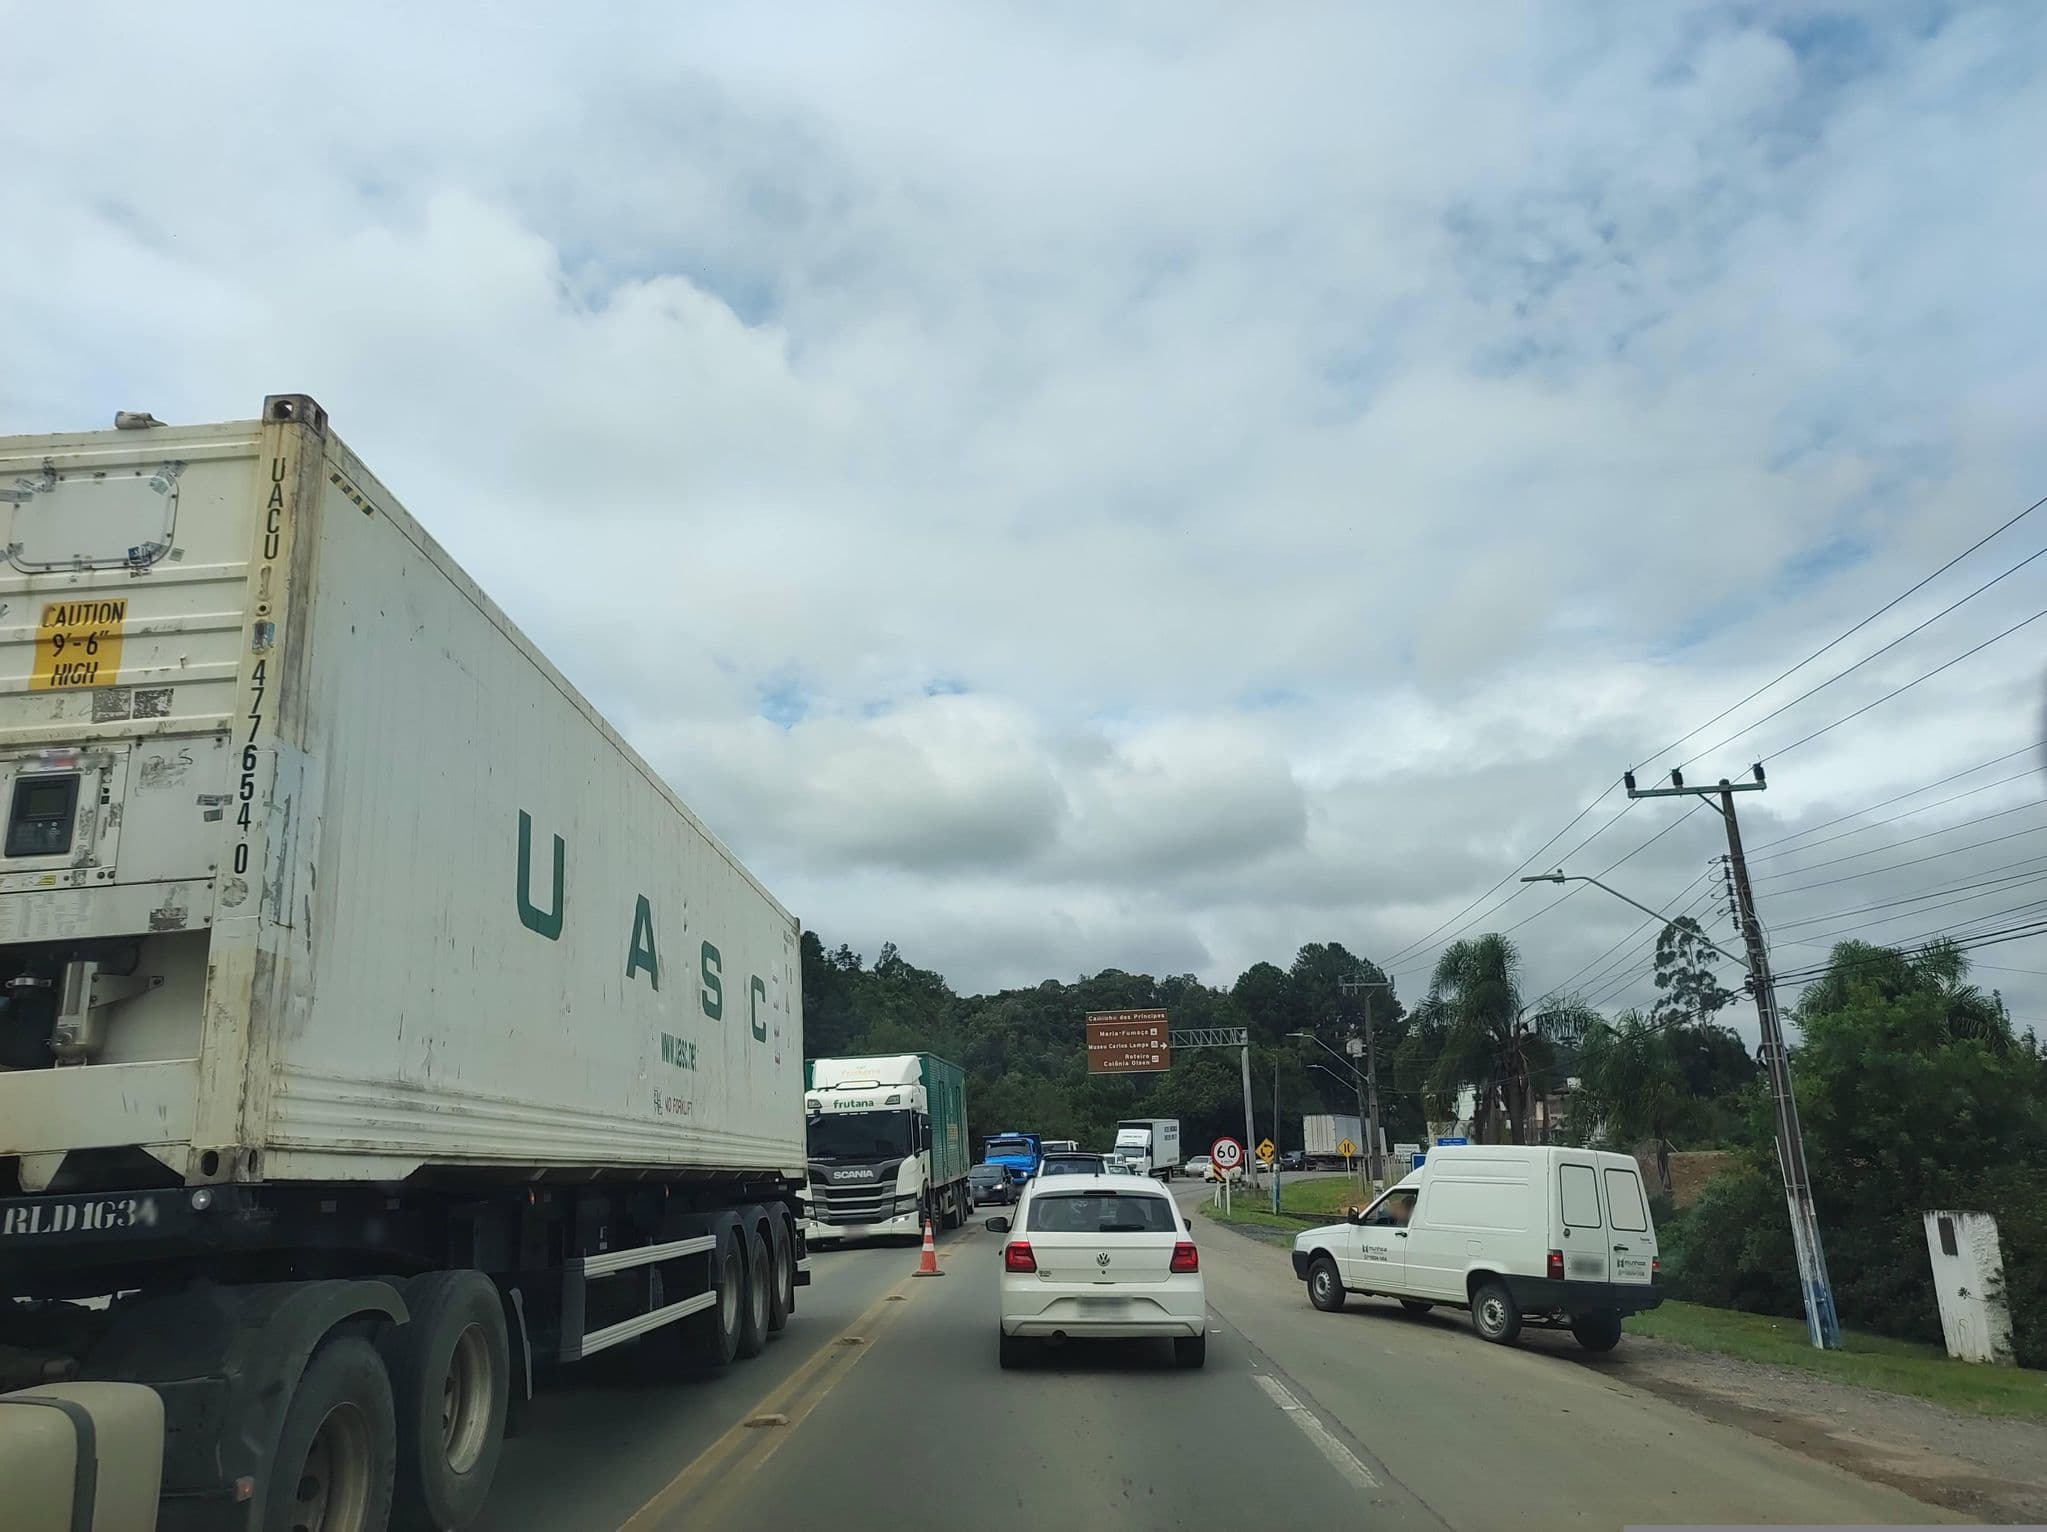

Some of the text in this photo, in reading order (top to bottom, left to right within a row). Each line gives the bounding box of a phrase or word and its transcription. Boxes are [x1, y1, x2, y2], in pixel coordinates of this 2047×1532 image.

[264, 457, 286, 560] UACU
[42, 601, 125, 628] CAUTION
[51, 661, 99, 686] HIGH
[517, 808, 766, 1043] UASC
[833, 1099, 875, 1109] frutana
[1217, 1145, 1237, 1159] 60
[833, 1169, 874, 1180] SCANIA
